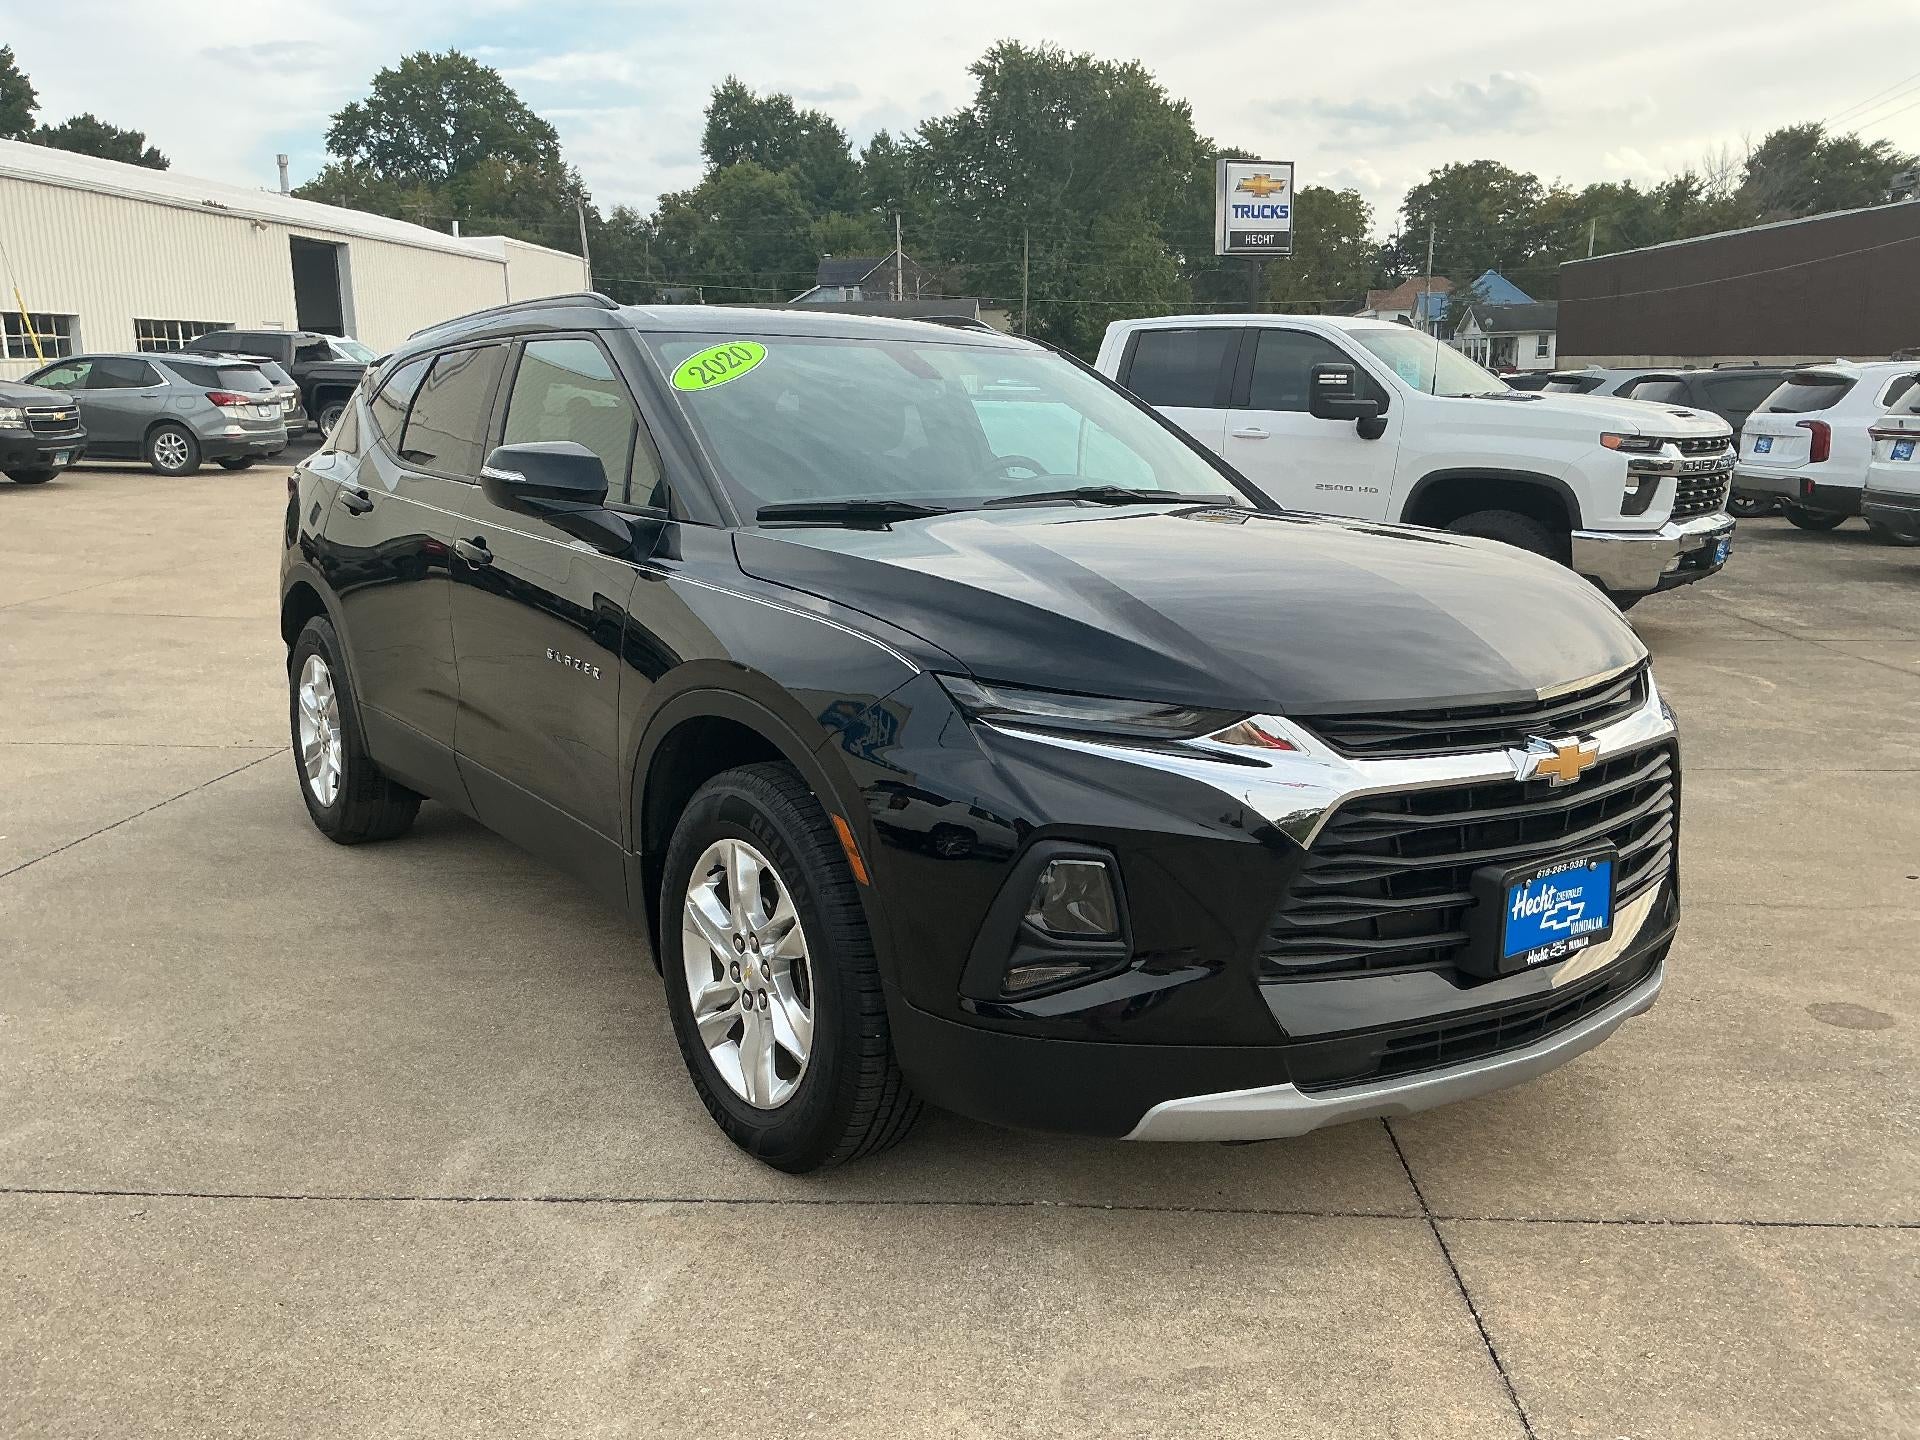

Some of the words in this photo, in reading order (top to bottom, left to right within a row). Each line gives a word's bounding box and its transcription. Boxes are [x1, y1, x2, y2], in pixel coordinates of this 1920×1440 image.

[1231, 204, 1289, 219] TRUCKS
[1245, 234, 1275, 245] HECHT
[688, 346, 753, 385] 2020
[1315, 483, 1354, 493] 2500
[1358, 486, 1379, 494] HD
[546, 647, 600, 680] BLAZER
[1511, 883, 1557, 921] Hecht
[1555, 886, 1584, 901] CHEVROLET
[1570, 916, 1603, 935] VANDALIA
[1526, 947, 1549, 965] Hecht
